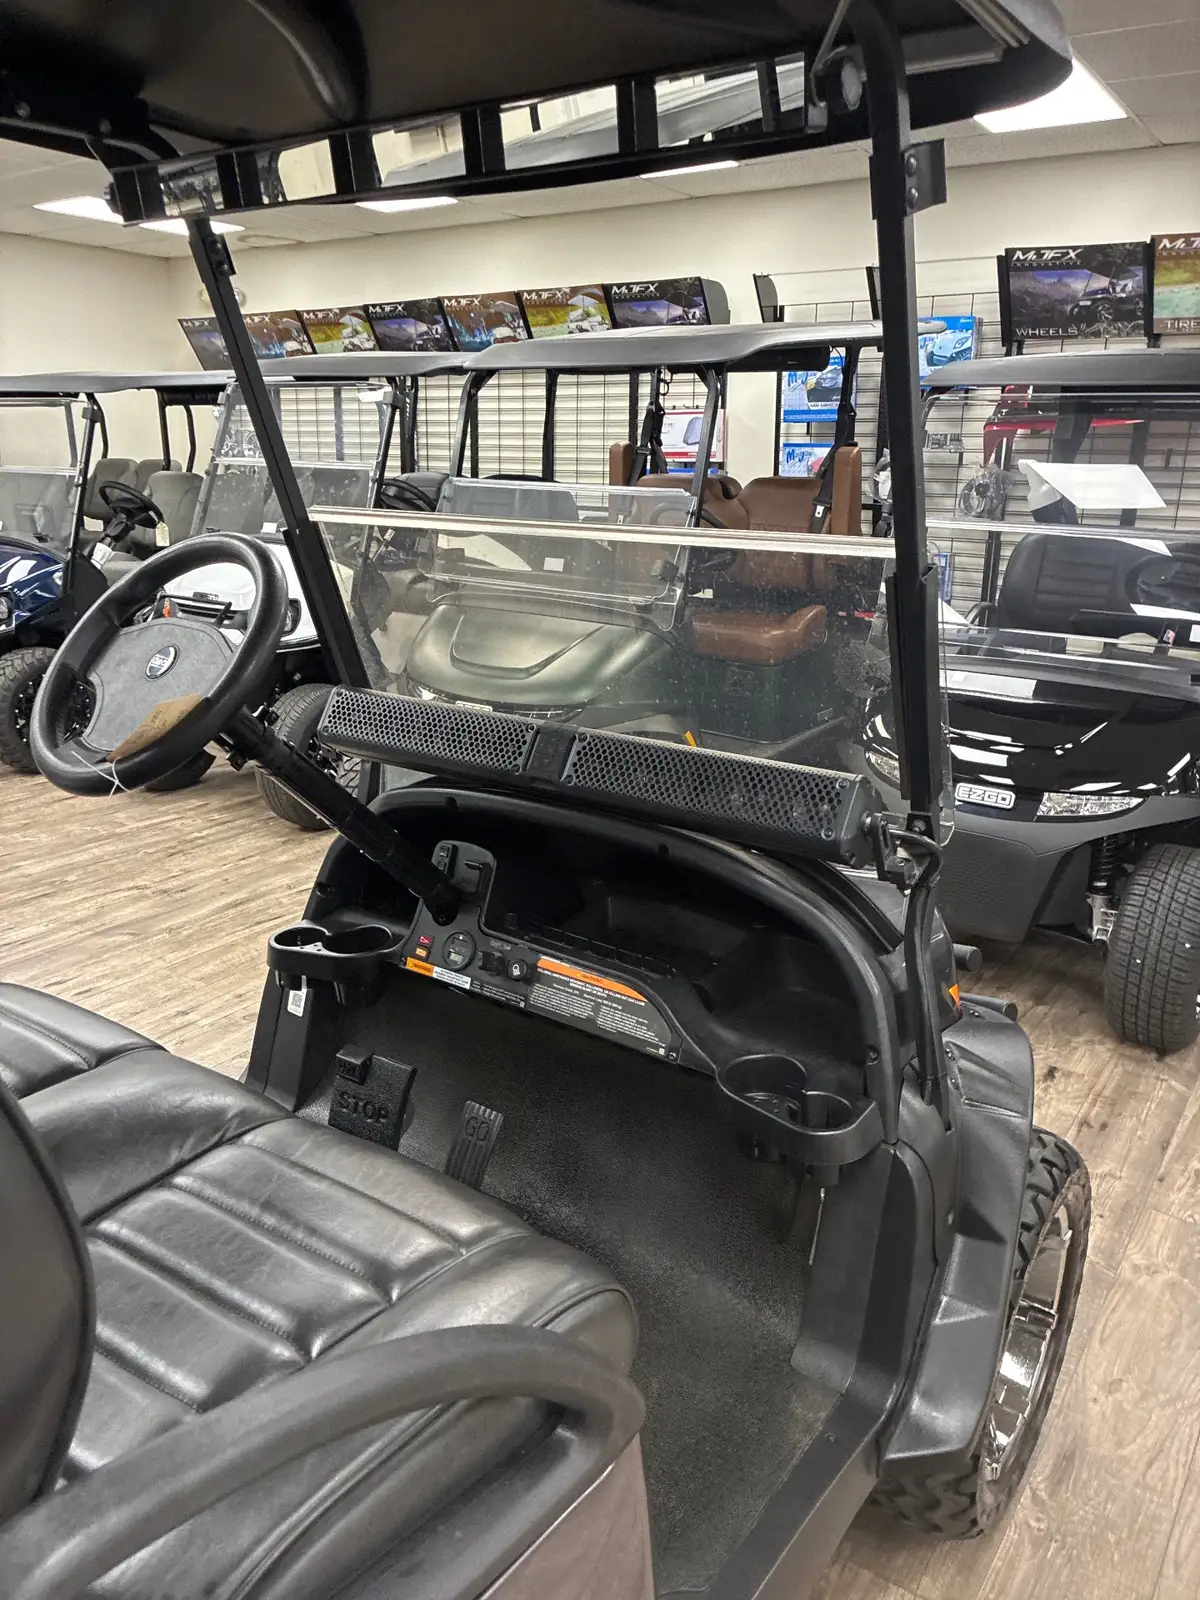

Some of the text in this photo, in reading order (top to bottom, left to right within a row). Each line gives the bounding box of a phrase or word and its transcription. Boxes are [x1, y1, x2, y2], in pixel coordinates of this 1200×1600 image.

[1016, 327, 1078, 337] WHEELS
[958, 786, 1012, 806] EZGO
[337, 1091, 390, 1123] STOP
[464, 1116, 490, 1142] GO
